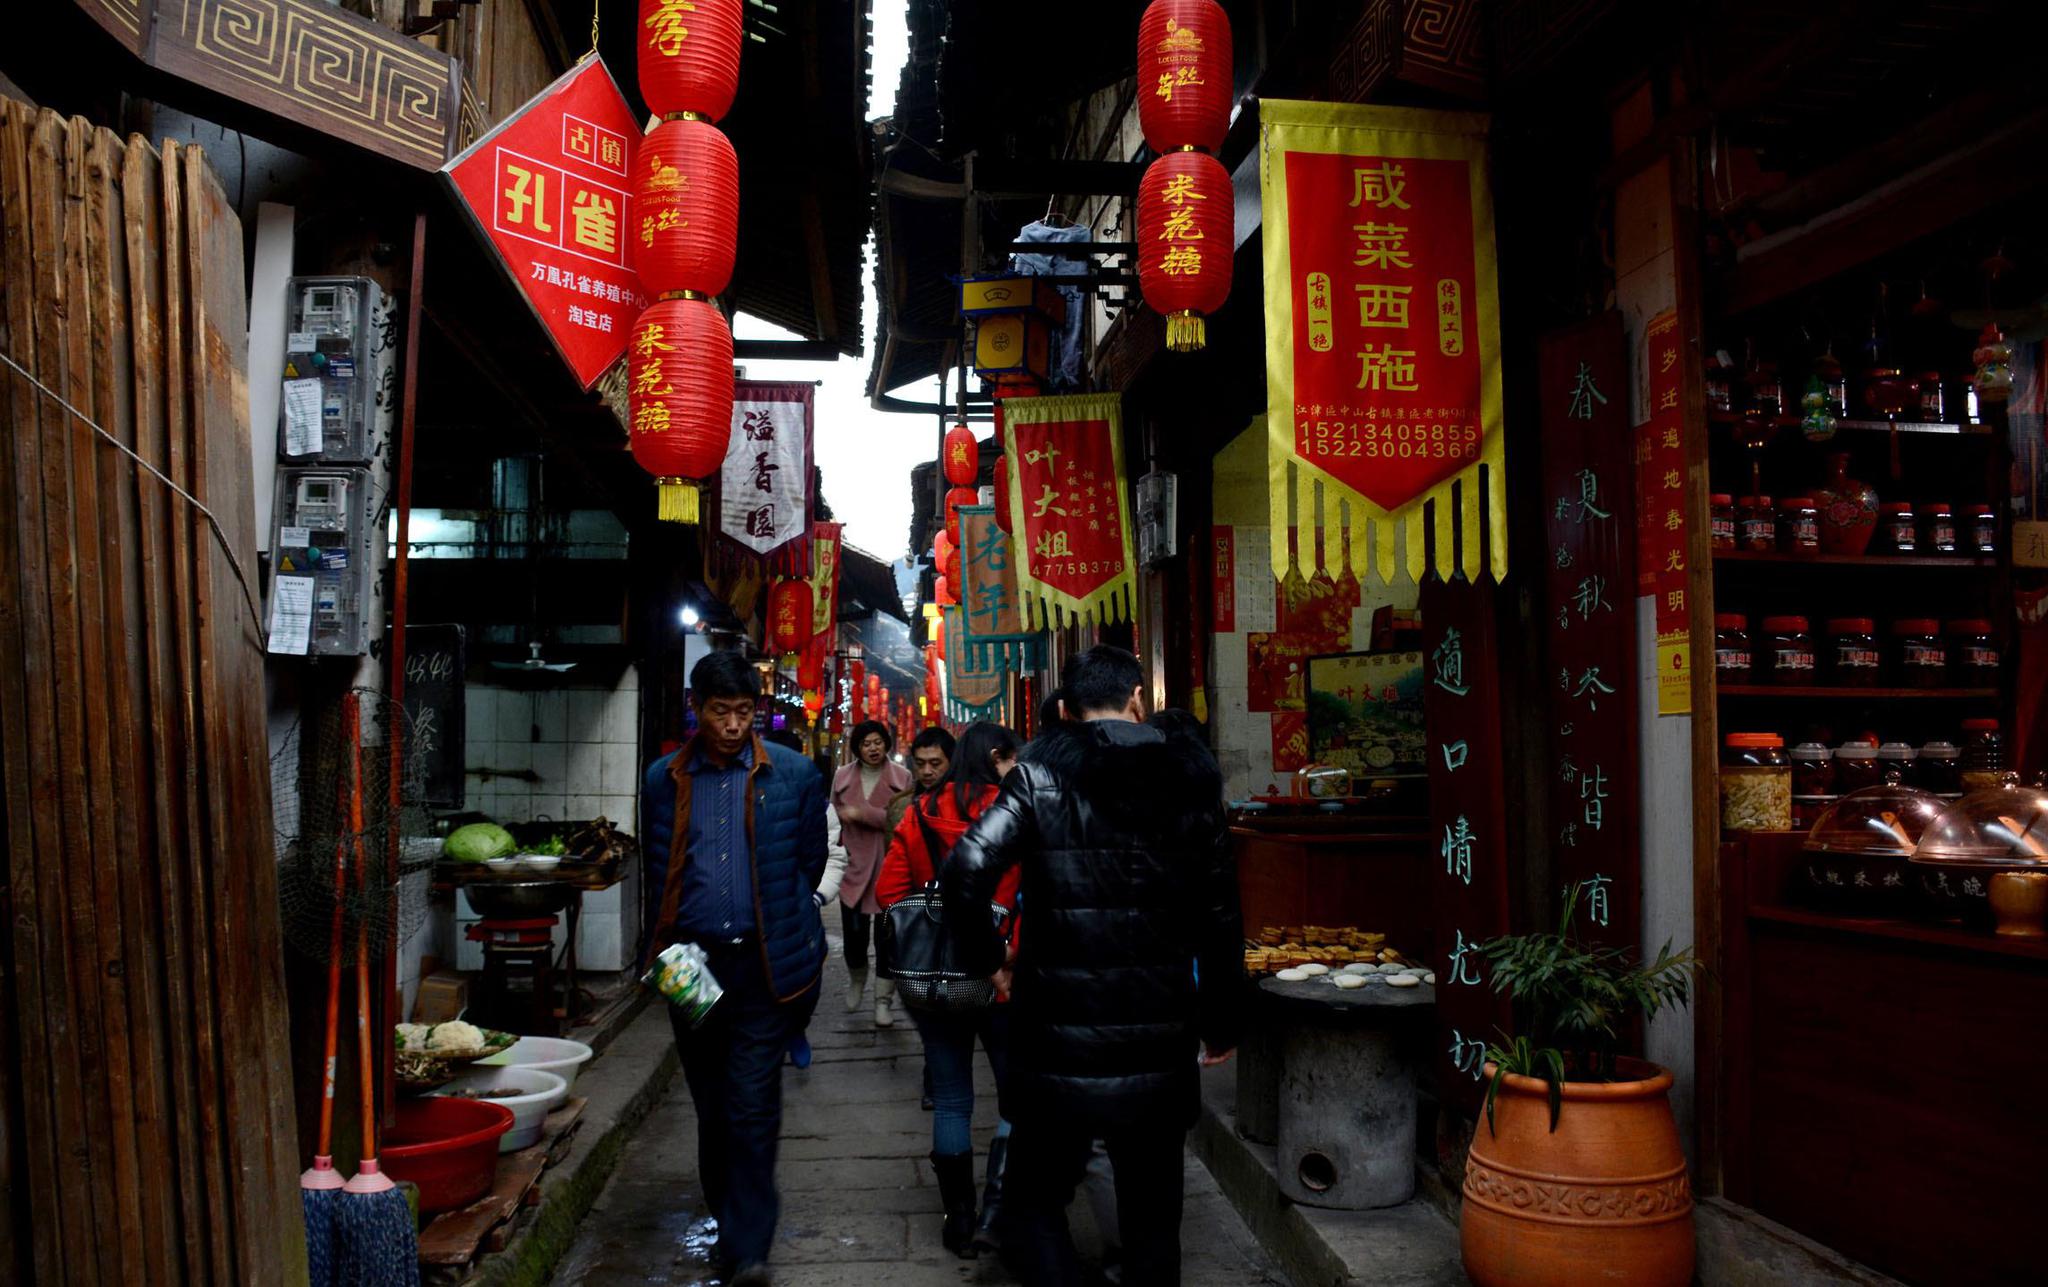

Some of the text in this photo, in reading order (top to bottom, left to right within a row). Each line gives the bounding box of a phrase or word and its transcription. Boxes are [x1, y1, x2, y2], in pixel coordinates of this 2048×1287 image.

[569, 126, 623, 167] 古镇
[504, 165, 617, 254] 孔雀
[1158, 172, 1208, 275] 米花糖
[1349, 161, 1419, 392] 咸菜西施
[568, 304, 613, 333] 淘宝店
[633, 323, 677, 434] 米花糖
[1300, 421, 1477, 441] 15213405855
[1301, 439, 1477, 459] 15223004366
[1024, 441, 1074, 559] 叶大姐
[1032, 560, 1122, 577] 47758378
